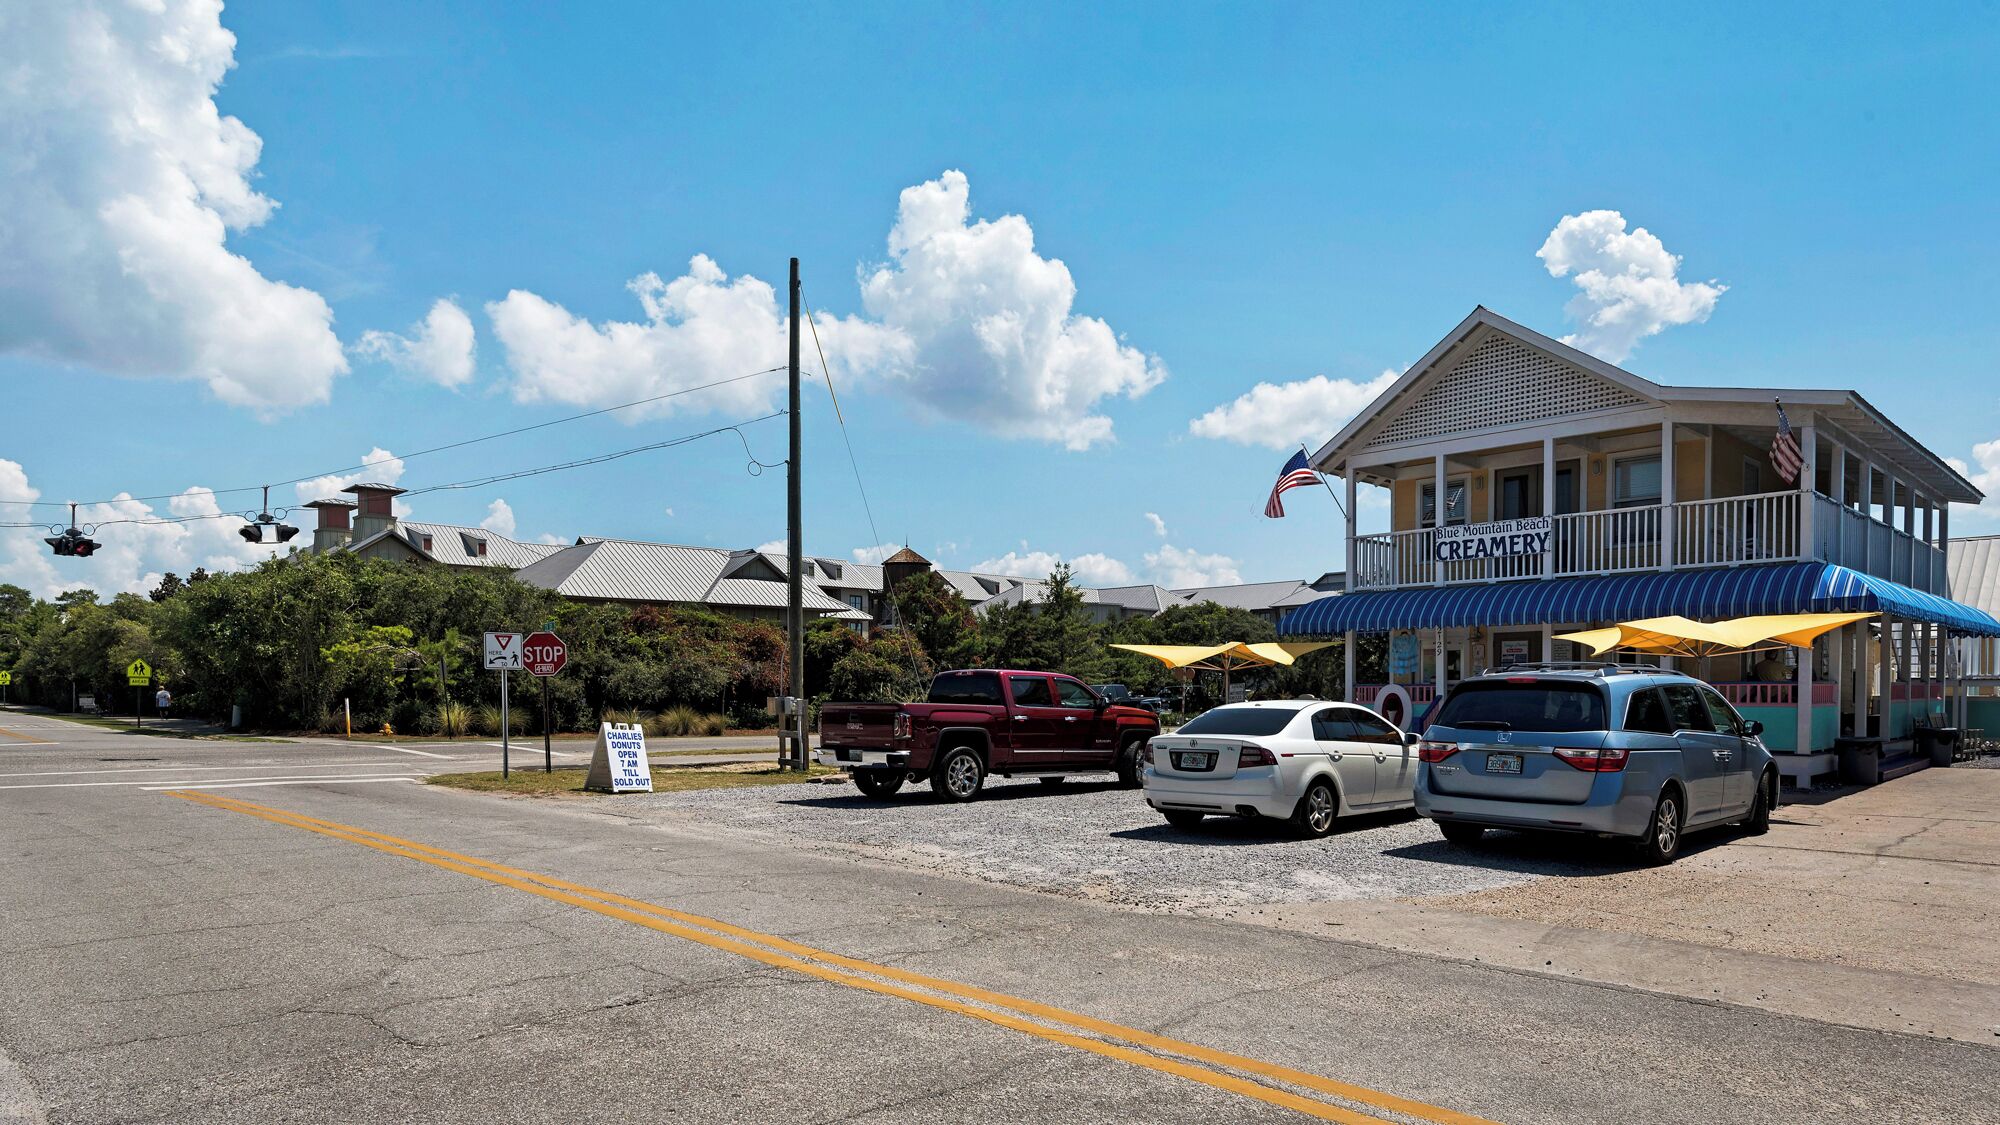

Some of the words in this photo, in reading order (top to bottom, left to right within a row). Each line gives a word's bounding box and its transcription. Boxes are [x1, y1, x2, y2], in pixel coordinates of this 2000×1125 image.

[1437, 527, 1460, 539] Blue
[1462, 521, 1513, 537] Mountain
[1516, 517, 1549, 532] Beach
[1436, 531, 1551, 561] CREAMERY
[524, 646, 563, 663] STOP
[607, 732, 643, 741] CHARLIES
[611, 741, 642, 750] DONUTS
[618, 750, 638, 759] OPEN
[622, 769, 639, 777] TILL
[614, 778, 634, 786] SOLD
[635, 778, 650, 786] OUT
